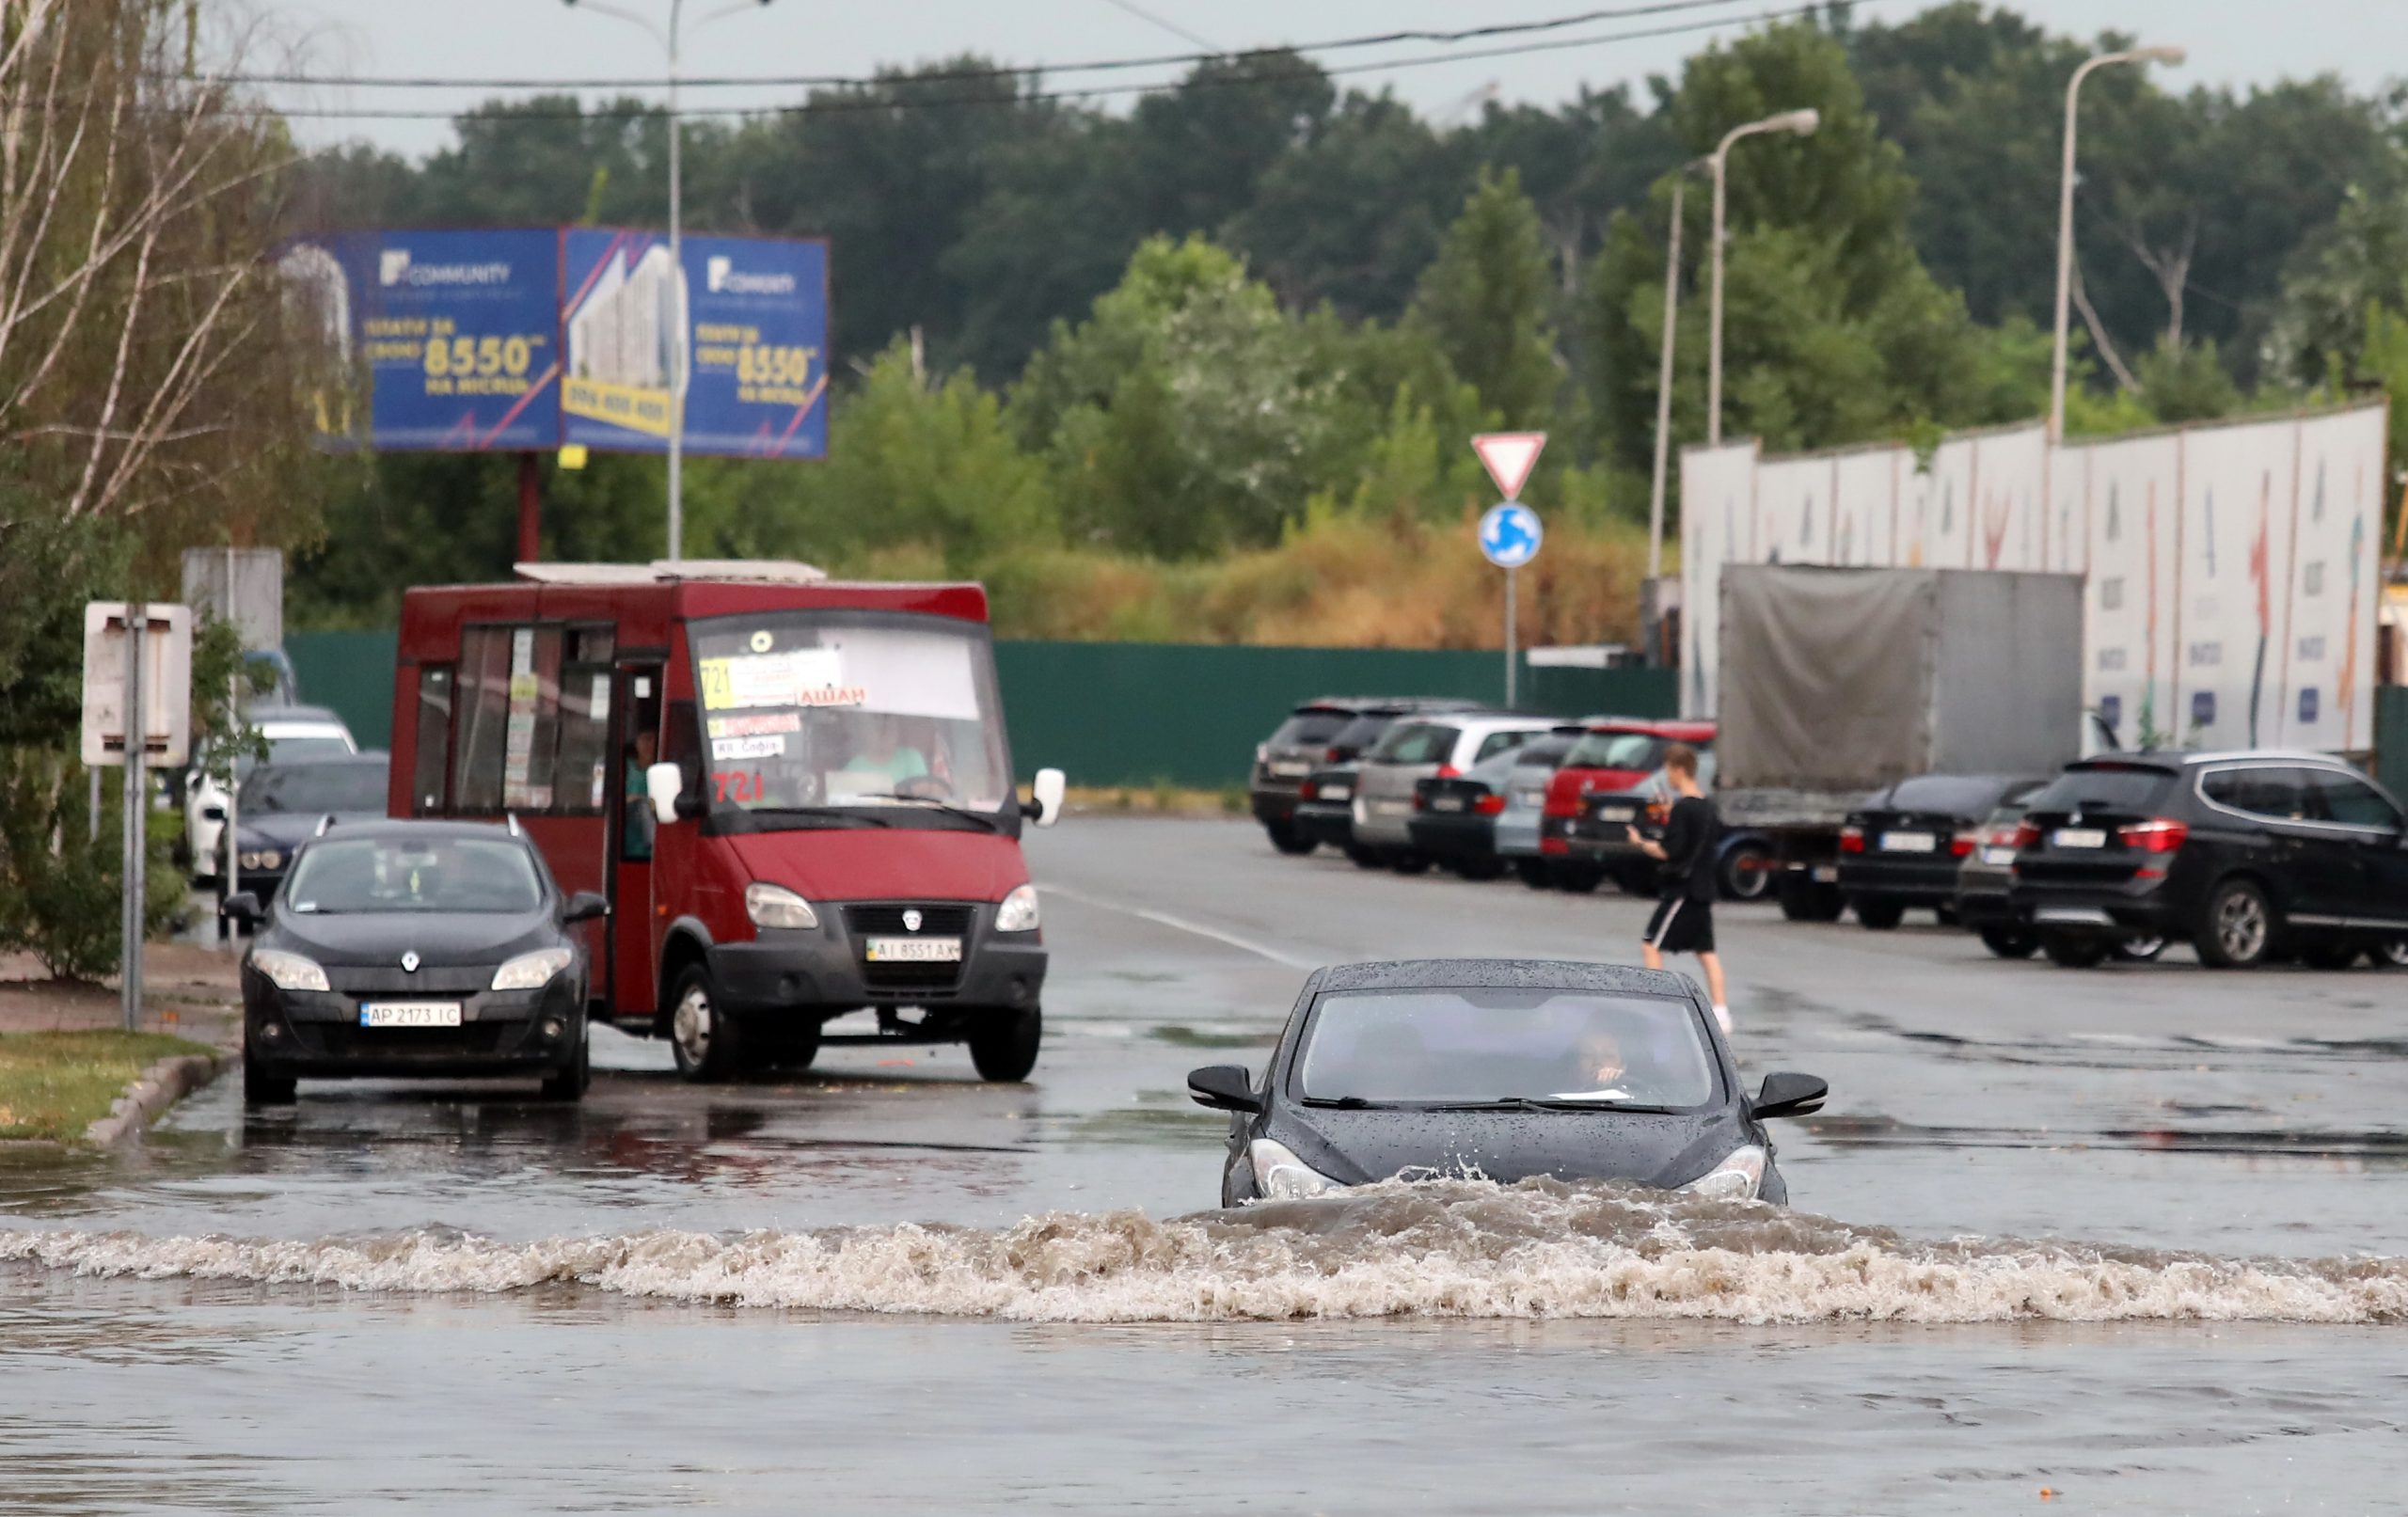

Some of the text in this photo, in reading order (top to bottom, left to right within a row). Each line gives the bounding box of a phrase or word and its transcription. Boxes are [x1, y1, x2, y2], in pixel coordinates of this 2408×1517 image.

[410, 263, 511, 285] COMMUNITY
[424, 336, 531, 375] 8550
[737, 345, 808, 386] 8550
[701, 666, 730, 694] 721
[802, 688, 866, 703] АШАН
[710, 769, 764, 802] 721
[371, 1008, 457, 1023] AP 2173 IC
